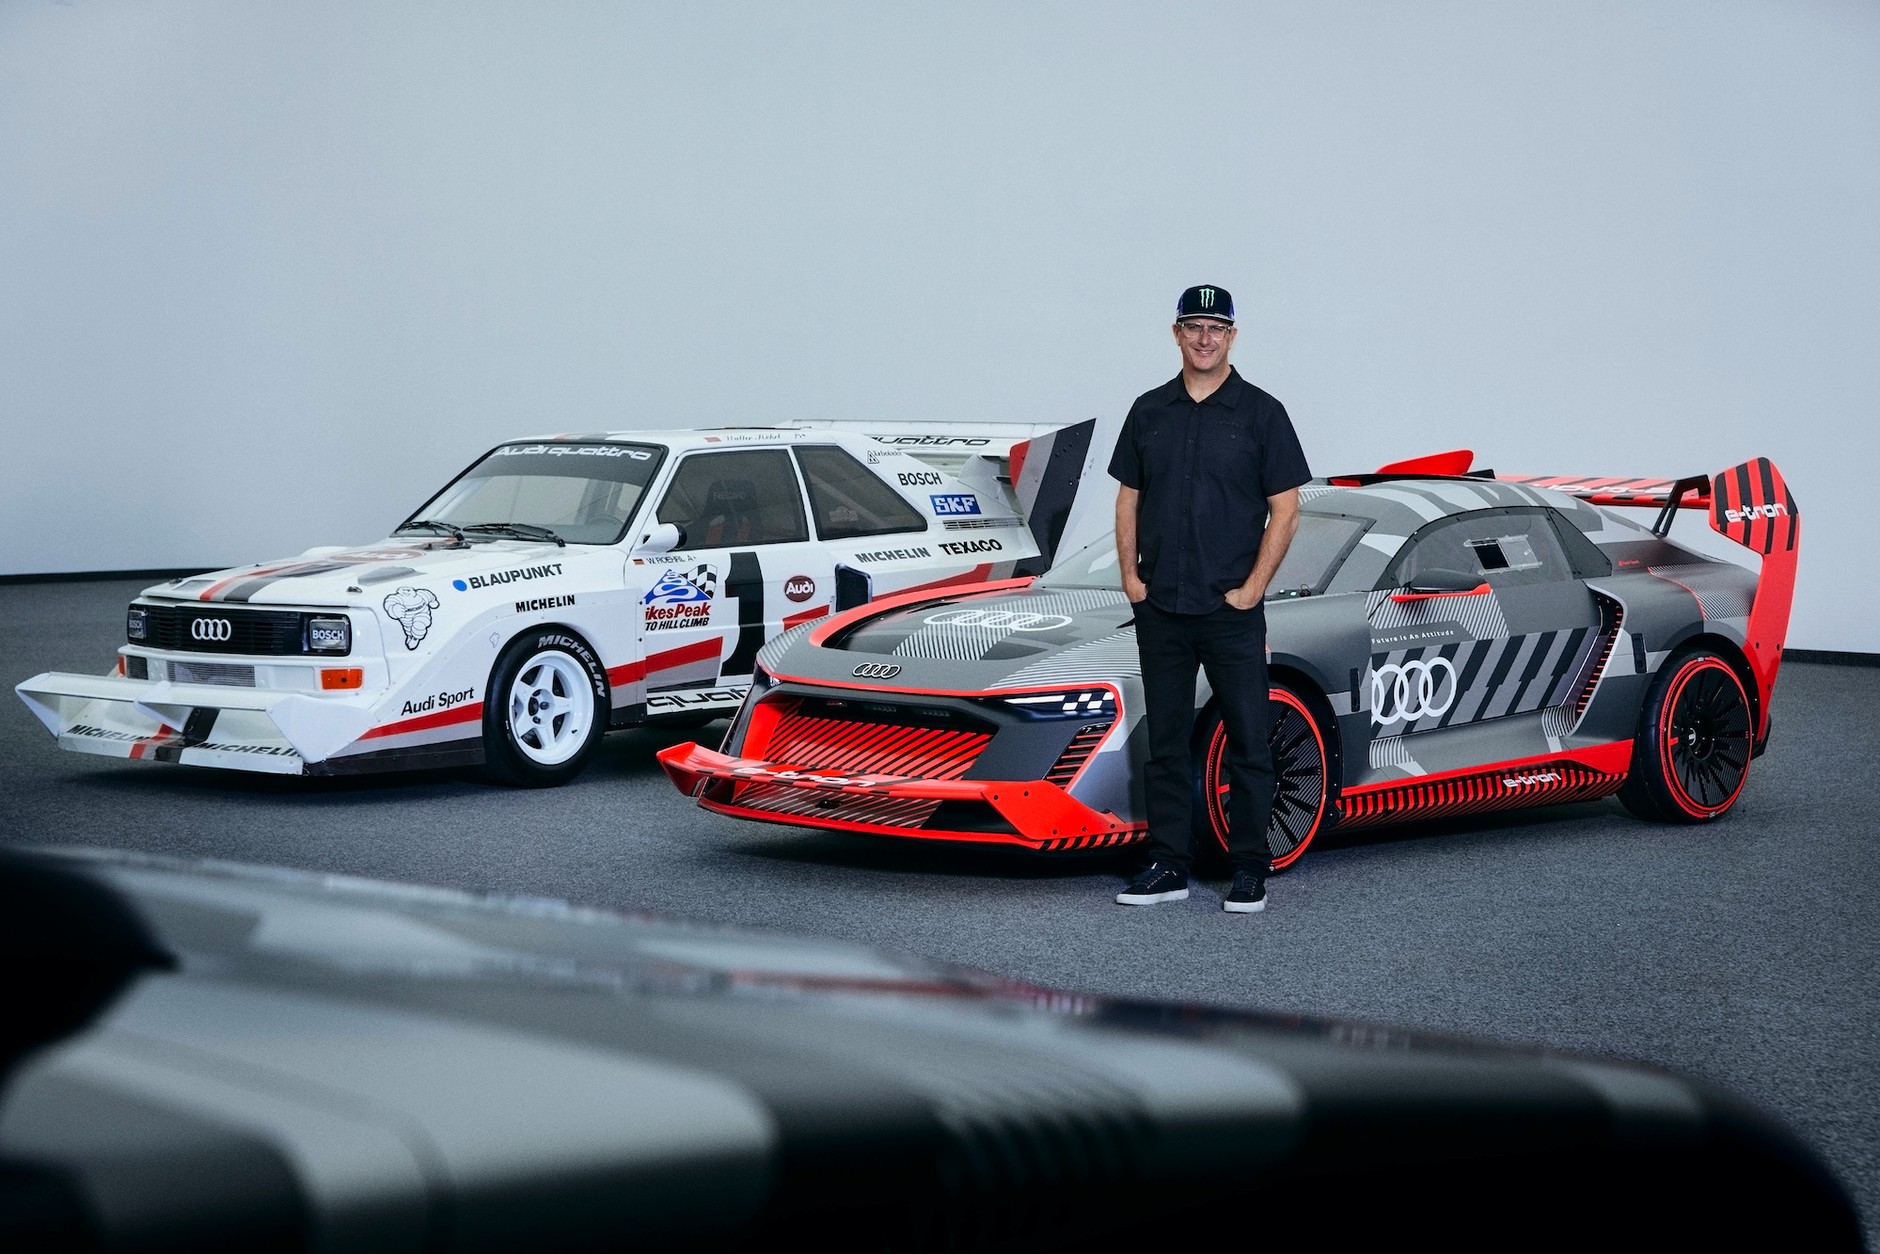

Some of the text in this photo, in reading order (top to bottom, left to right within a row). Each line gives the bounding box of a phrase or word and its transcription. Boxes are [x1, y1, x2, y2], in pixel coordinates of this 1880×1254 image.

[872, 436, 991, 446] uattro
[493, 444, 652, 461] Audi quattro
[897, 472, 943, 486] BOSCH
[934, 496, 975, 514] SKF
[1725, 503, 1788, 523] e-tron
[854, 546, 931, 563] MICHELIN
[938, 538, 1003, 556] TEXACO
[469, 563, 563, 589] BLAUPUNKT
[785, 581, 814, 595] Audi
[515, 594, 576, 613] MICHELIN
[645, 602, 712, 620] ikes Peak
[720, 551, 766, 677] 1
[658, 619, 678, 630] HILL
[680, 617, 710, 628] CLIMB
[312, 629, 344, 640] BOSCH
[1421, 630, 1454, 638] Attitude
[538, 634, 606, 698] MICHELIN
[401, 686, 475, 716] Audi Sport
[67, 724, 151, 741] MICHELIN
[732, 767, 877, 787] e-tron
[1502, 773, 1561, 787] e-tron
